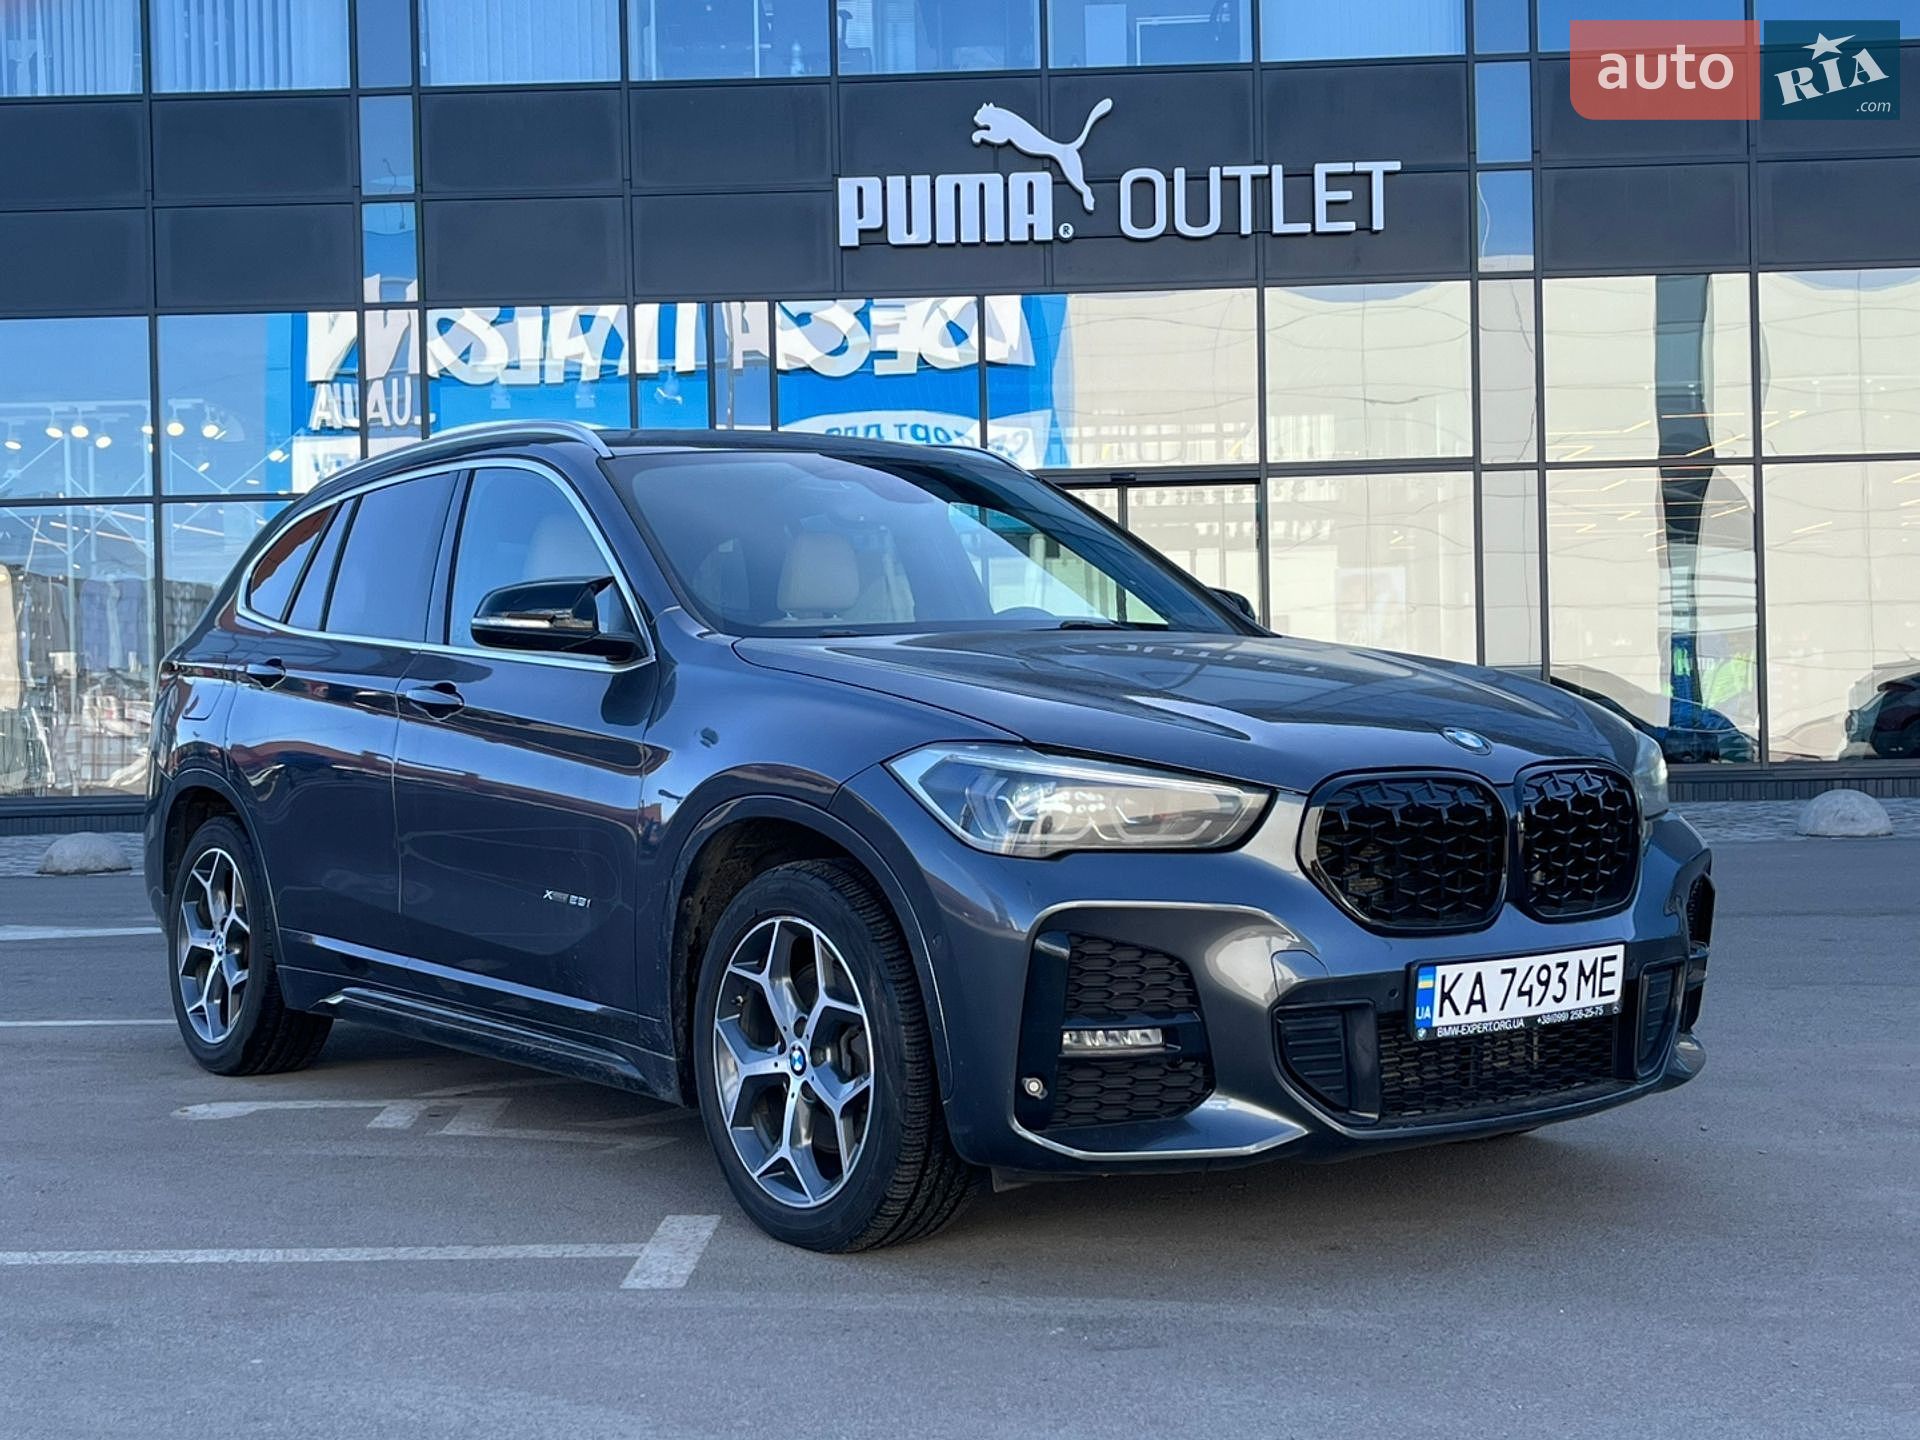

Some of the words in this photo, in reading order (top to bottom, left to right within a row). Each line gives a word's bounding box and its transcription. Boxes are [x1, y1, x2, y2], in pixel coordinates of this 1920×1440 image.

[838, 171, 1053, 248] PUMA
[1118, 160, 1402, 240] OUTLET
[1415, 1005, 1432, 1020] UA
[1438, 971, 1488, 1018] KA
[1499, 961, 1570, 1011] 7493
[1576, 954, 1618, 1001] ME
